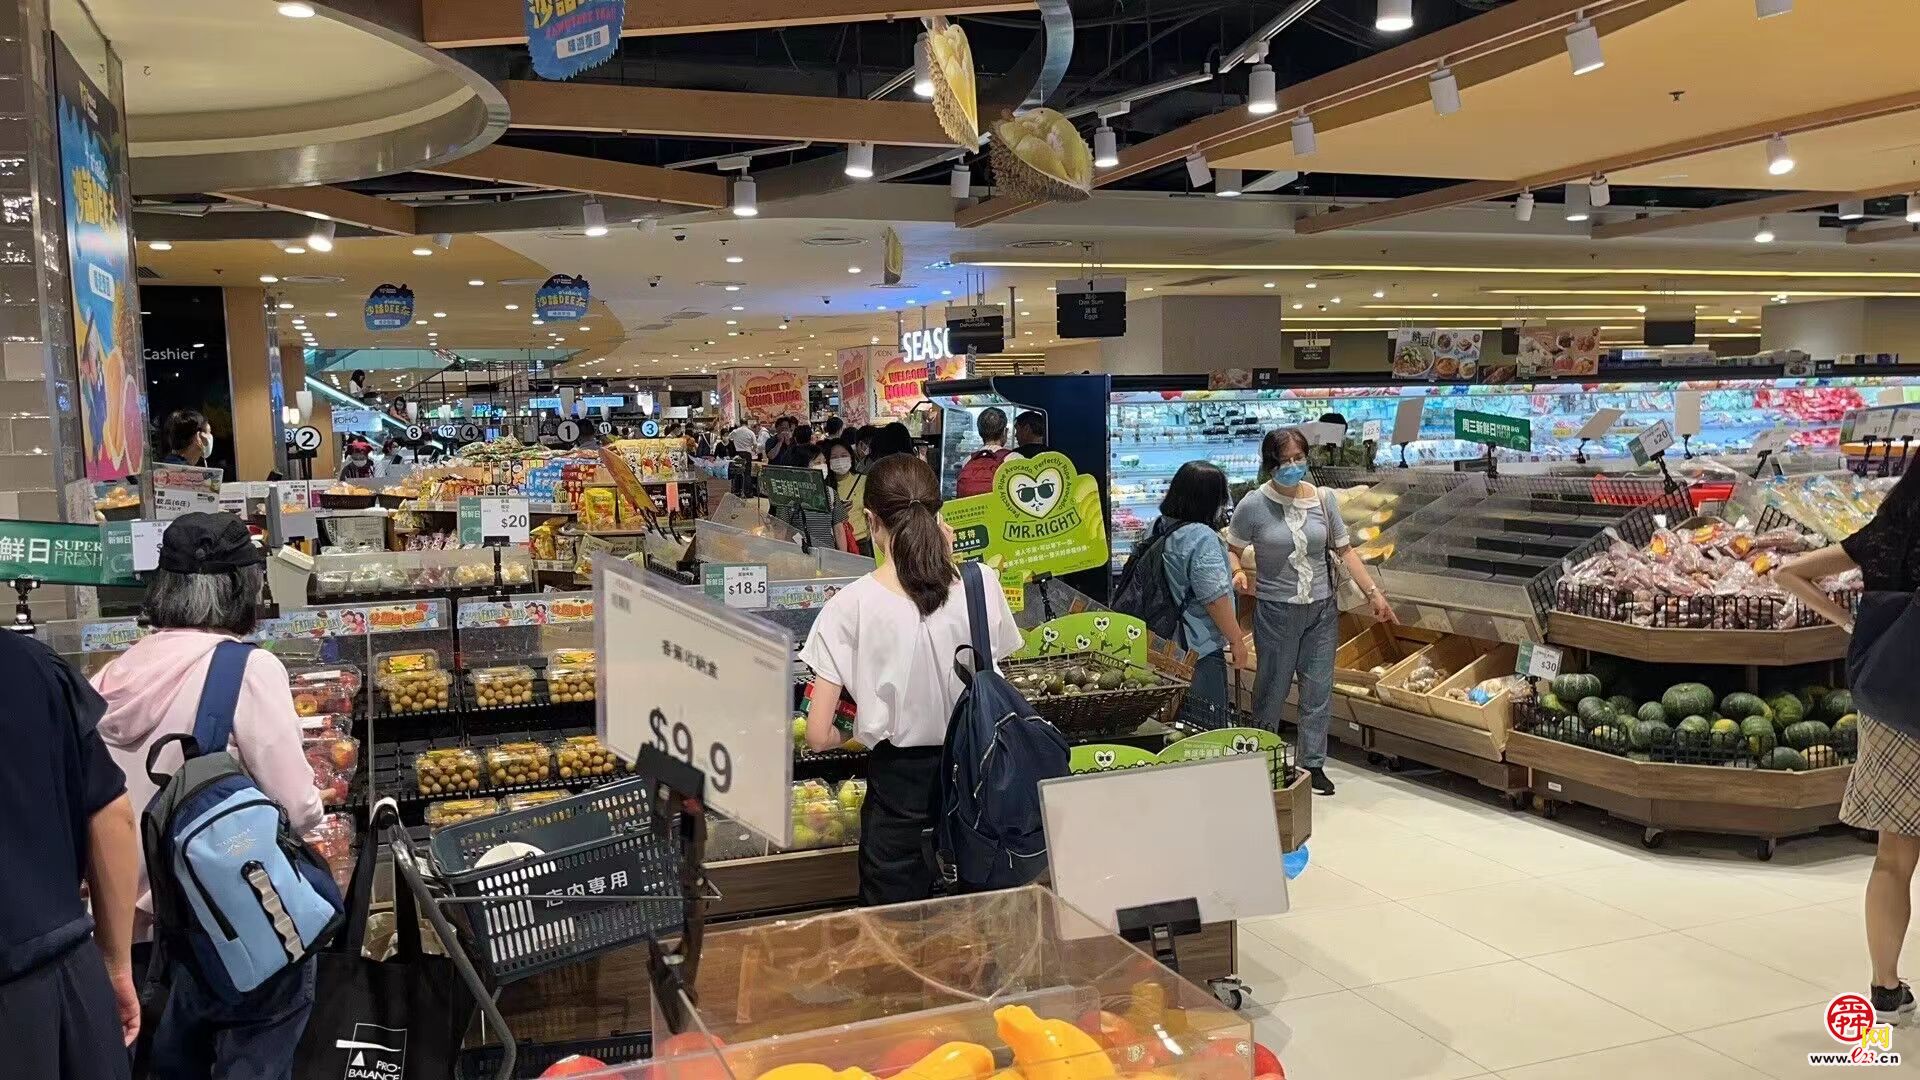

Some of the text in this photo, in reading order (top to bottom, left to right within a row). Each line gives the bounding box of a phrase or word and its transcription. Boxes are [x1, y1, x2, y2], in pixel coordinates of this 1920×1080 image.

[971, 308, 978, 317] 3
[143, 348, 195, 360] Cashier
[749, 381, 791, 395] WELCOME TO
[884, 381, 920, 401] HONG
[746, 389, 801, 408] HONG KONG
[410, 427, 419, 438] 8
[444, 428, 454, 437] 12
[465, 426, 475, 439] 4
[565, 425, 571, 440] 1
[601, 425, 610, 435] 11
[646, 423, 655, 435] 3
[301, 430, 314, 447] 2
[1005, 464, 1034, 476] Avocado
[1034, 457, 1062, 471] Perfectly
[998, 490, 1020, 519] Perfectly
[502, 515, 528, 529] $20
[1008, 512, 1076, 540] MR.RIGHT
[55, 540, 103, 552] SUPER
[54, 552, 103, 567] FRESH
[728, 581, 767, 595] $18.5
[1541, 661, 1557, 673] $30
